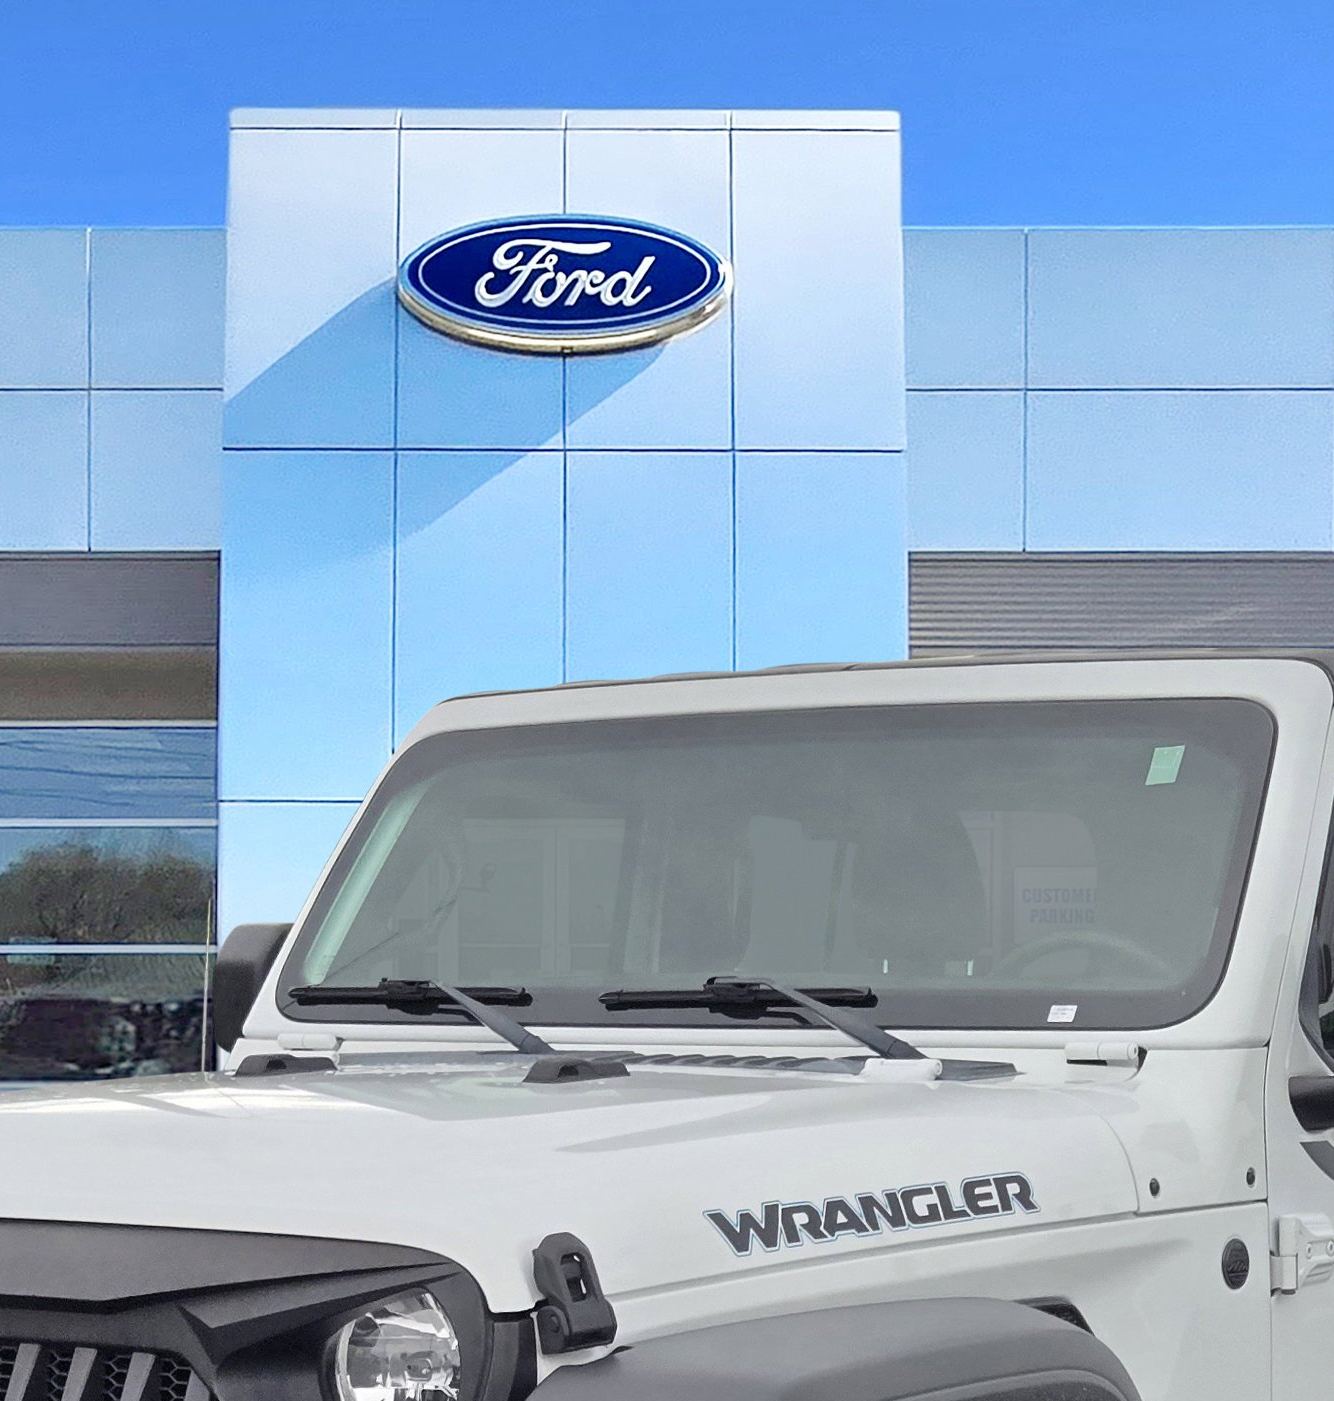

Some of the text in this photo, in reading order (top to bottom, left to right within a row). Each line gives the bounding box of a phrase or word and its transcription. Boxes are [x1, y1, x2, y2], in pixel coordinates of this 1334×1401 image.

[474, 238, 656, 308] Ford
[1030, 909, 1095, 924] PARKING
[703, 1172, 1041, 1257] WRANGLER
